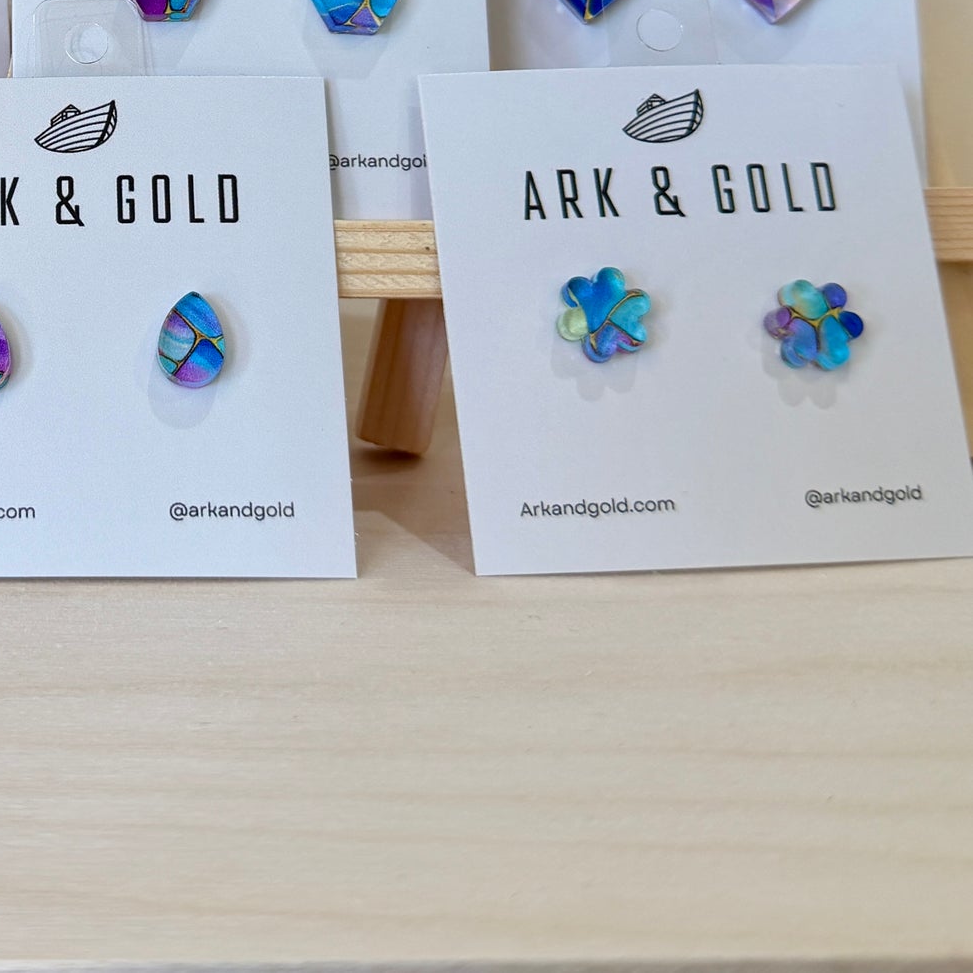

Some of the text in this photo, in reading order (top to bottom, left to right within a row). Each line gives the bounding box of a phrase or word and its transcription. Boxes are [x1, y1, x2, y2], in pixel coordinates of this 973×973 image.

[56, 176, 84, 226] &
[117, 174, 239, 224] GOLD
[525, 163, 836, 220] ARK & GOLD
[521, 498, 675, 518] Arkandgold.com
[805, 485, 923, 508] @arkandgold
[170, 502, 295, 522] @arkandgold
